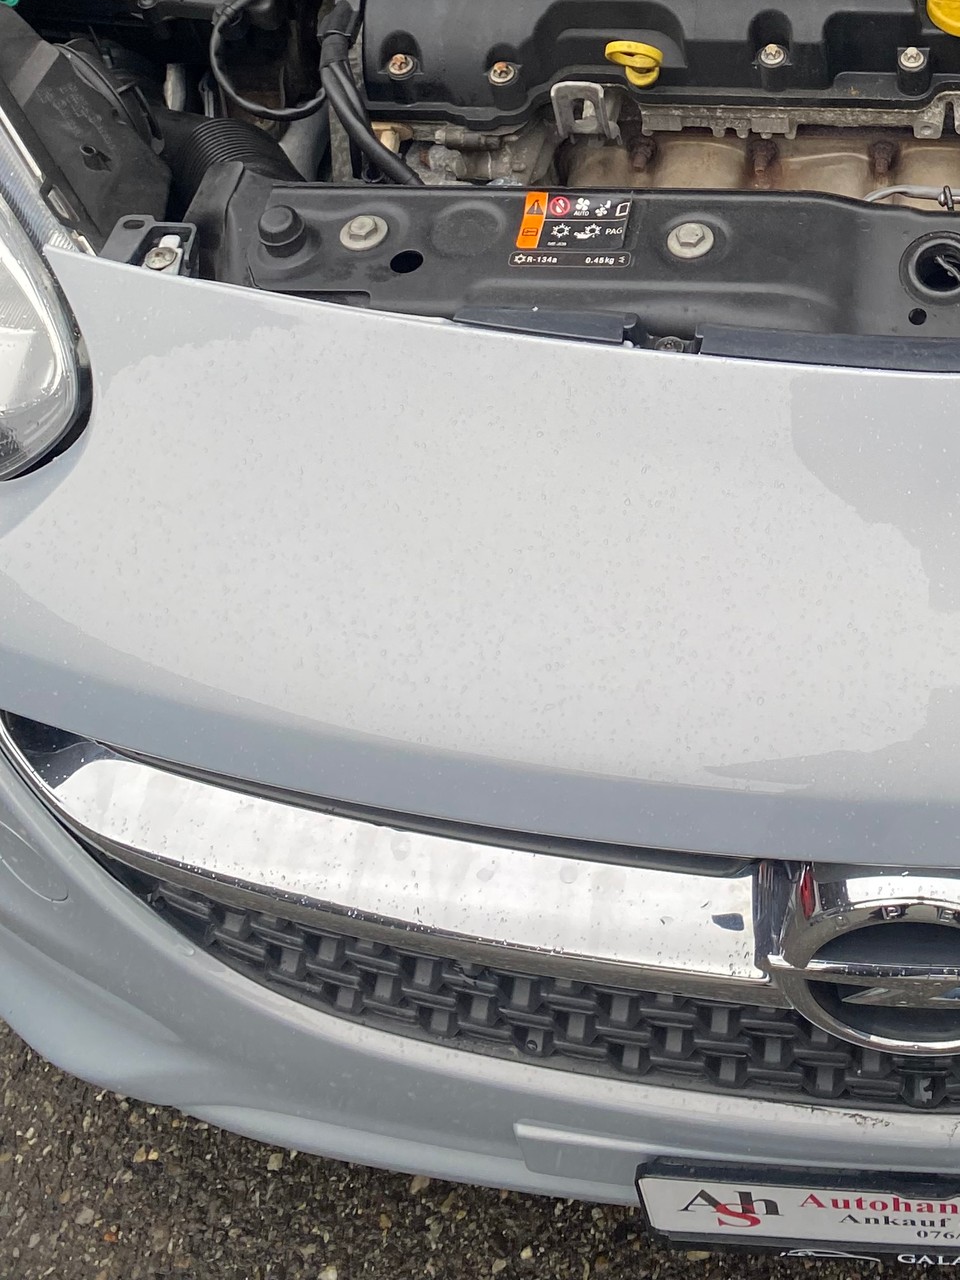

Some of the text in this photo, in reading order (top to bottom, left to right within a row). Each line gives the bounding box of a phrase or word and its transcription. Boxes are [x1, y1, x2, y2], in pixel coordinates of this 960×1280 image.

[605, 226, 623, 235] PAG
[526, 256, 558, 264] R-134a
[838, 1213, 952, 1228] Ankauf
